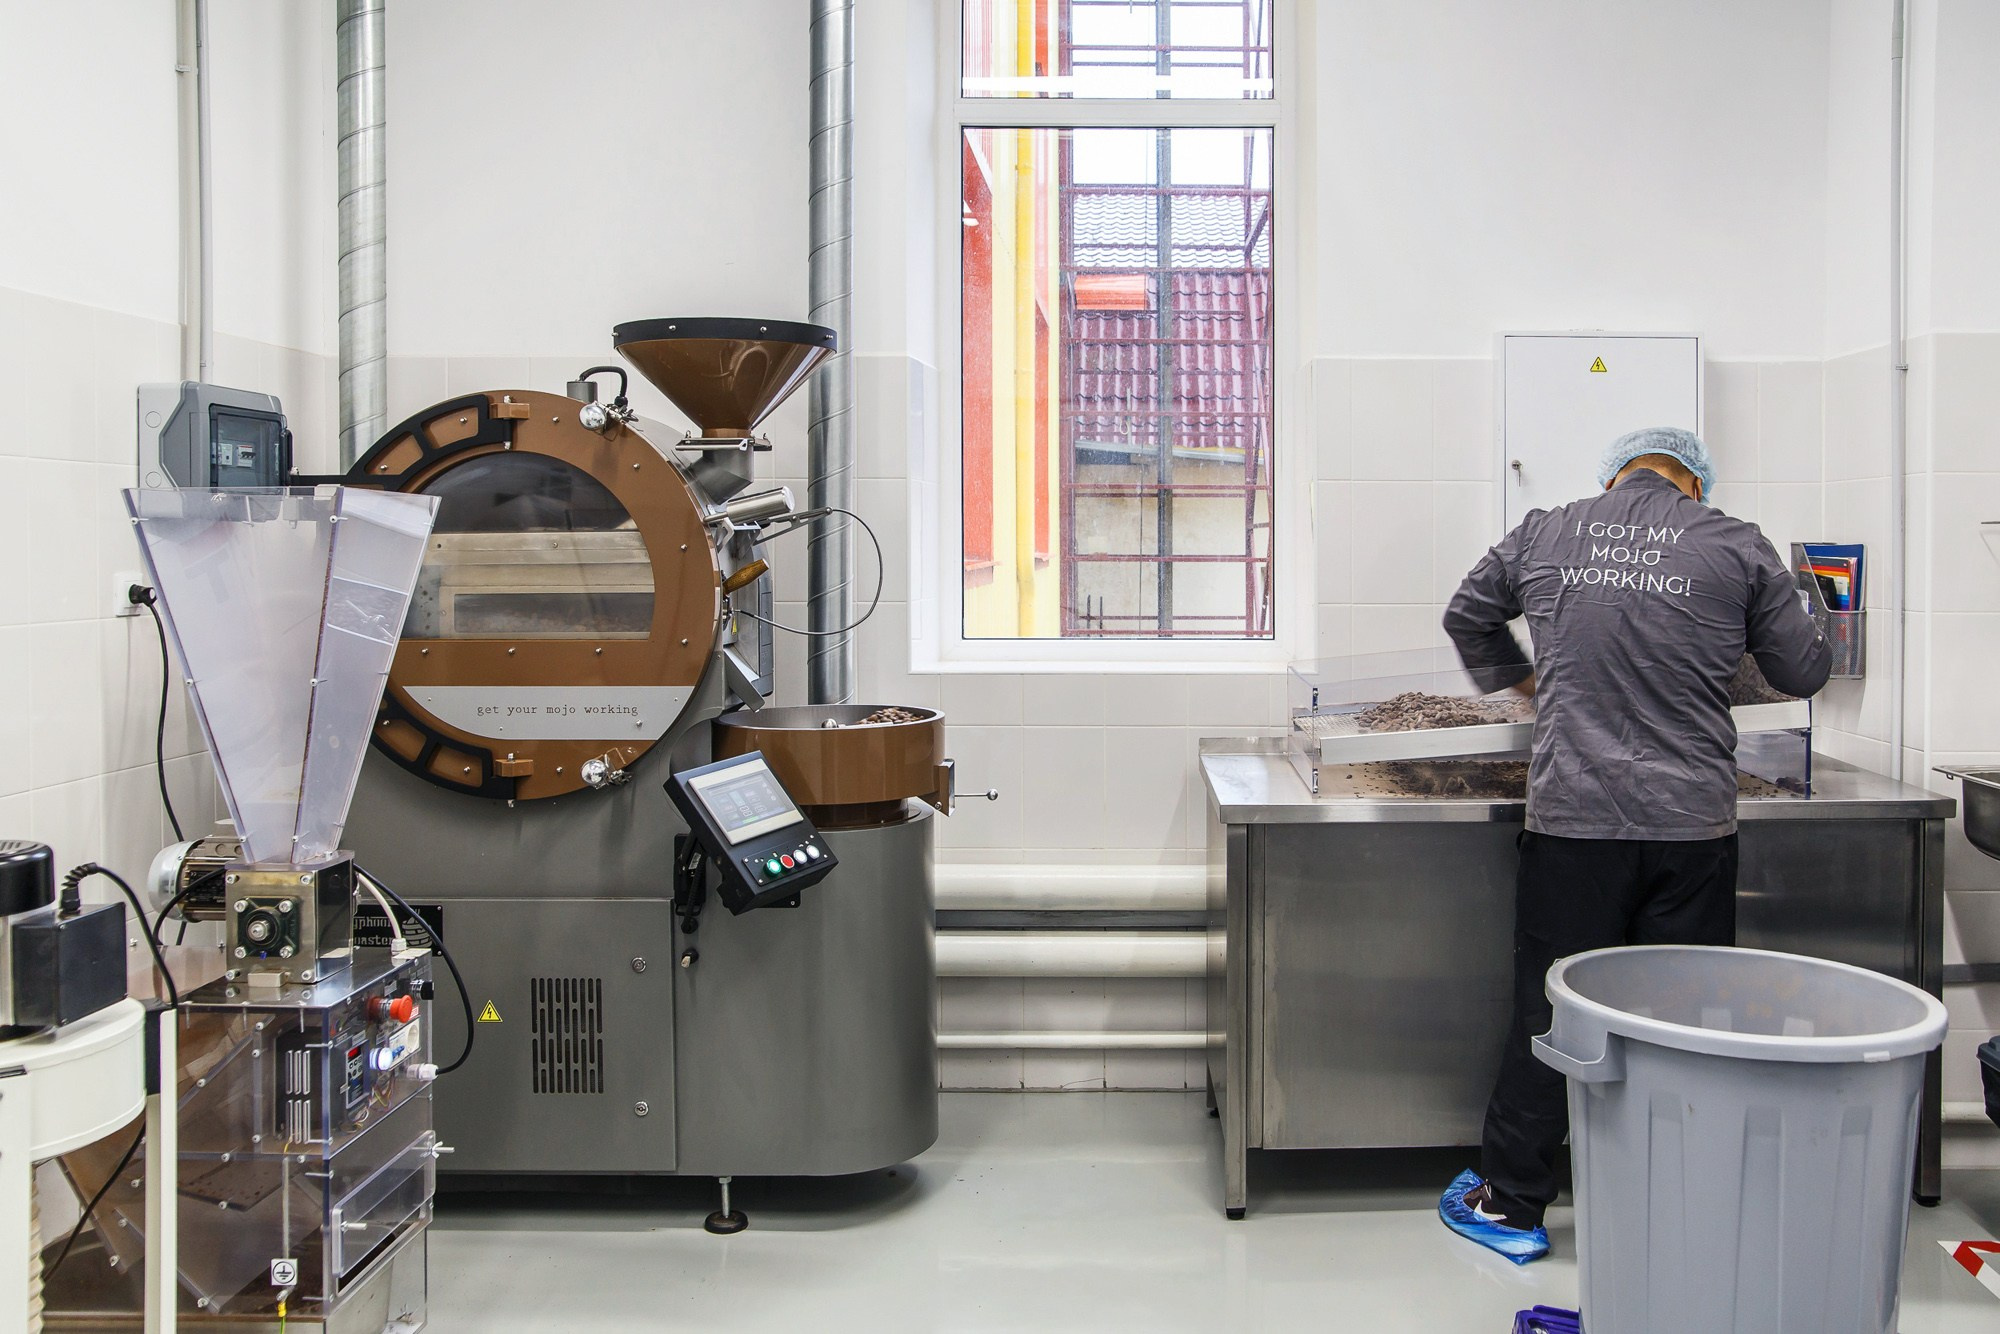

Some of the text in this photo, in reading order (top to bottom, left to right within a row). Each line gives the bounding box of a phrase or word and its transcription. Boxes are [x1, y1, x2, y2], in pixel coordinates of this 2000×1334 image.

[1575, 520, 1685, 544] I GOT MY
[1590, 543, 1661, 566] MOJO
[1560, 567, 1691, 597] WORKING!
[476, 704, 640, 717] get your mojo working
